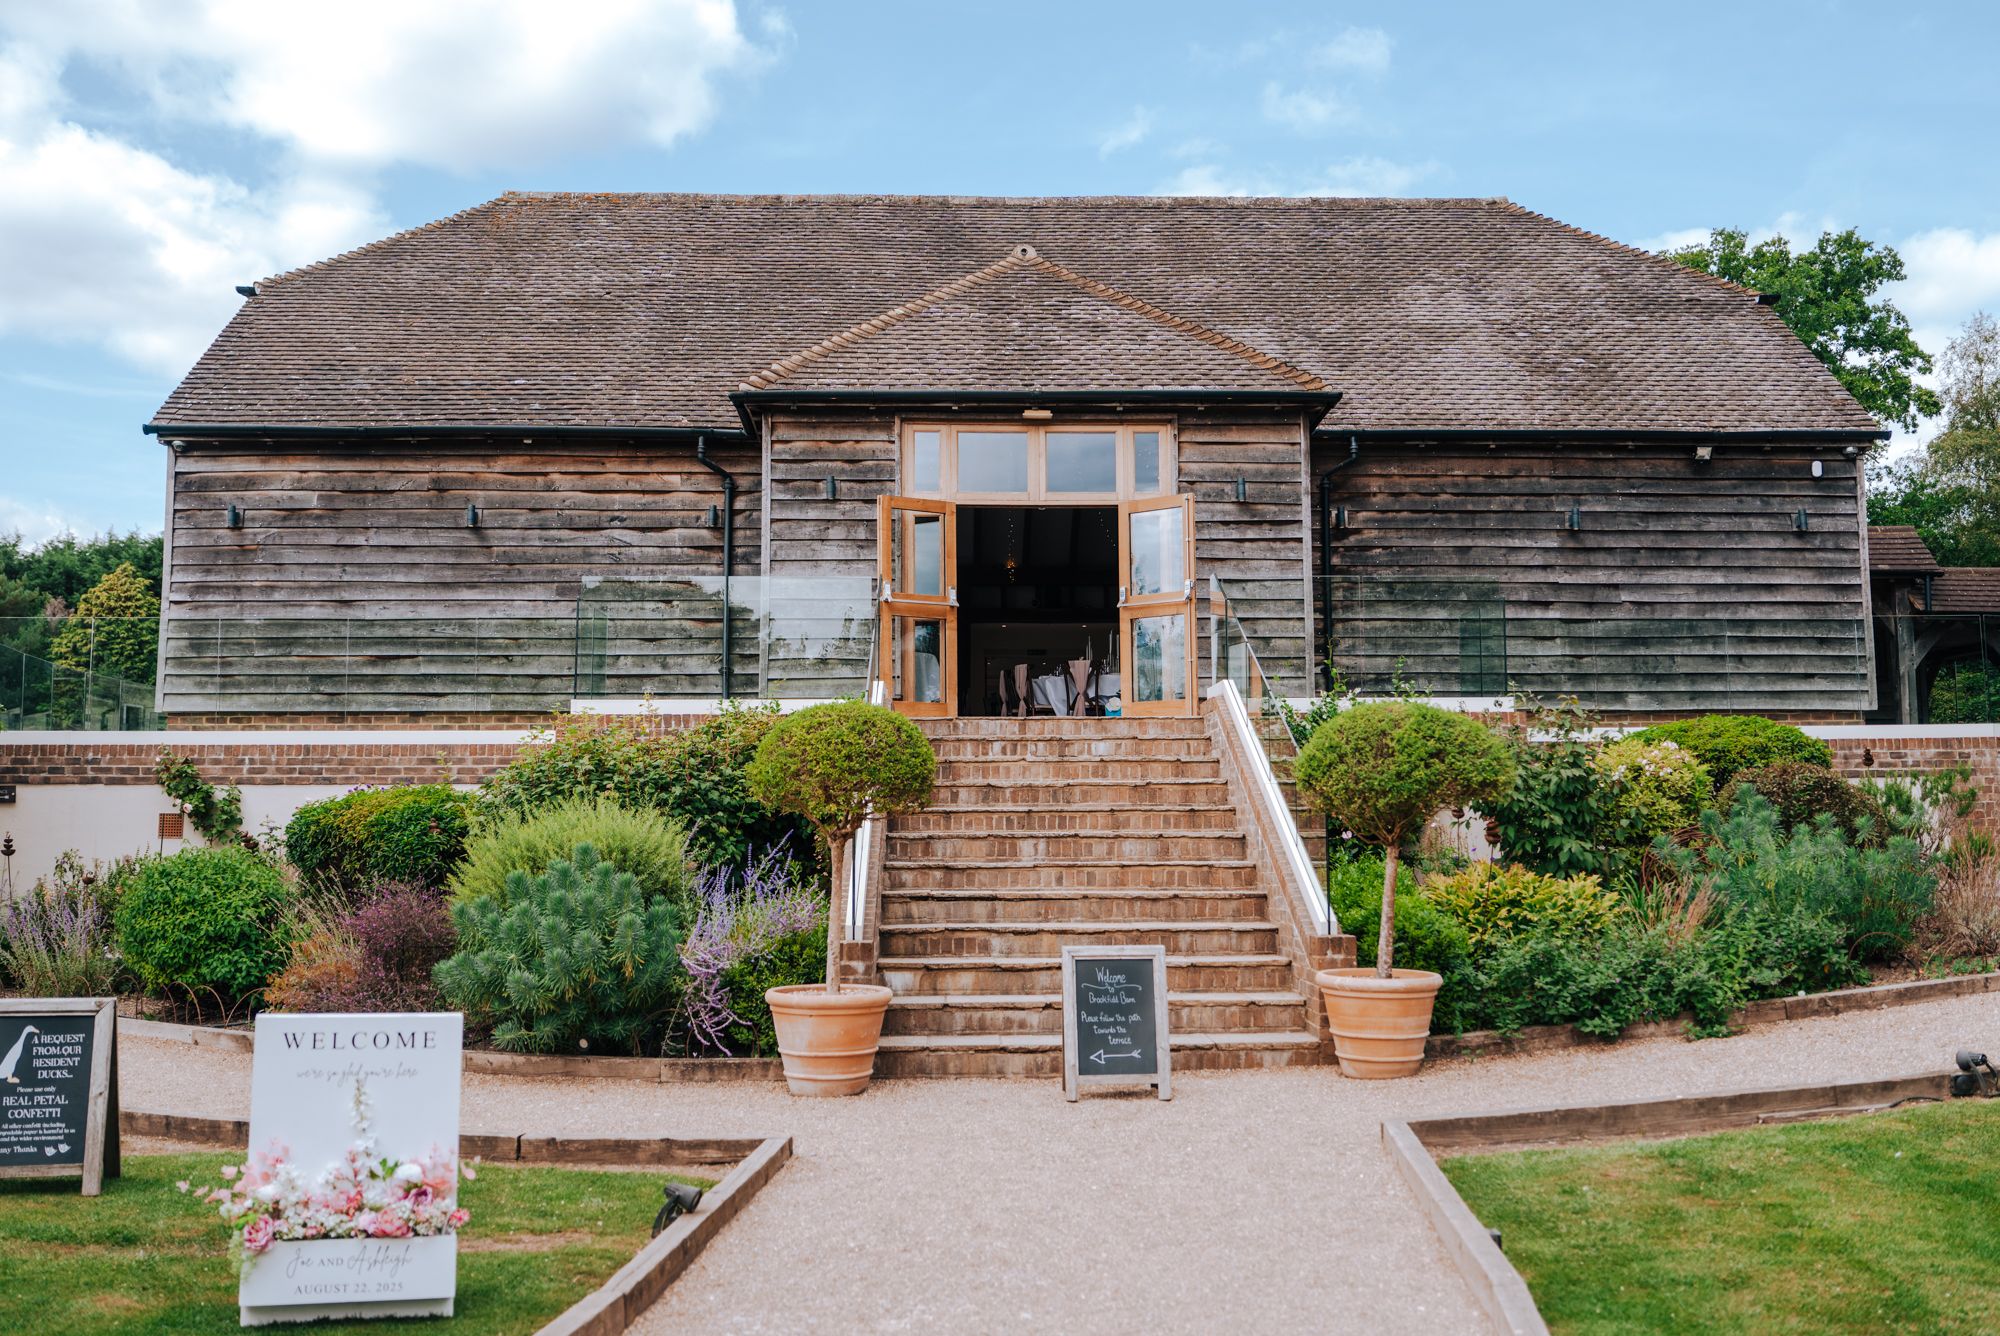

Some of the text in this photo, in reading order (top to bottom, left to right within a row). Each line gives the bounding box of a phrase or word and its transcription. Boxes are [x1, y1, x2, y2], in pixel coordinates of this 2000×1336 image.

[1095, 966, 1126, 983] Welcome
[1081, 1010, 1099, 1022] Please
[1115, 1013, 1125, 1021] the
[1128, 1013, 1141, 1024] path
[1093, 1025, 1116, 1034] towards
[32, 1033, 85, 1044] A REQUEST
[283, 1031, 437, 1050] WELCOME
[1108, 1034, 1132, 1045] terrace
[62, 1045, 82, 1056] OUR
[33, 1057, 80, 1067] RESIDENT
[395, 1061, 418, 1079] here
[44, 1085, 56, 1093] only
[3, 1095, 68, 1106] REAL PETAL
[8, 1107, 61, 1119] CONFETTI
[286, 1248, 313, 1279] Joe
[318, 1257, 344, 1267] AND
[295, 1284, 349, 1295] AUGUST
[375, 1281, 403, 1293] 2025
